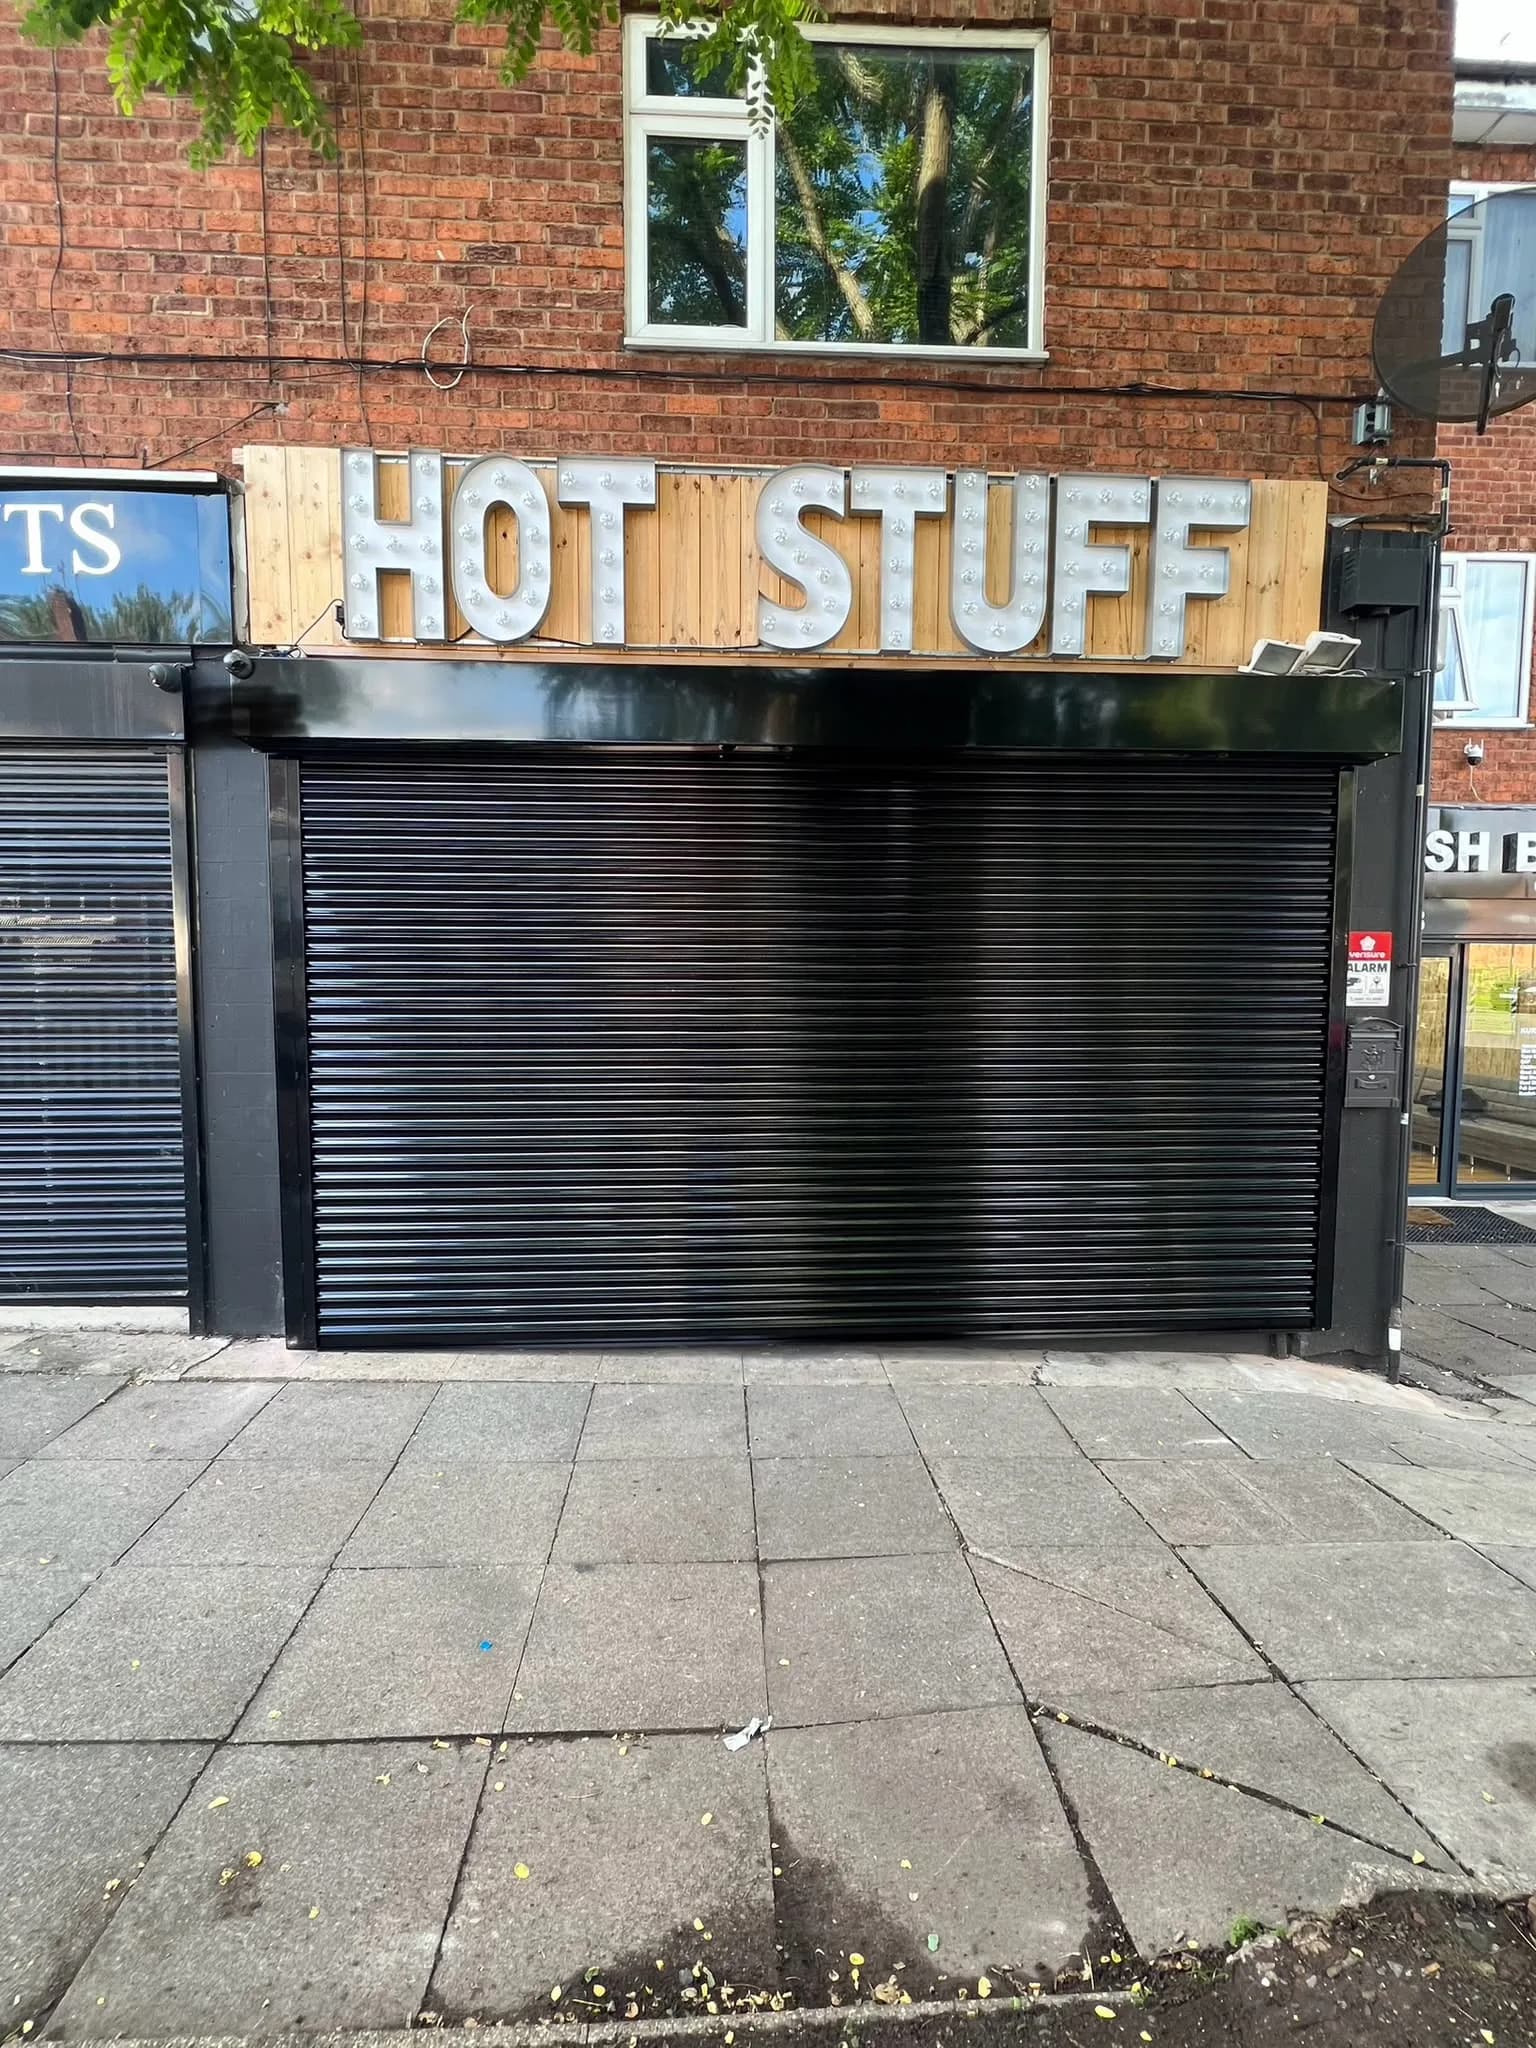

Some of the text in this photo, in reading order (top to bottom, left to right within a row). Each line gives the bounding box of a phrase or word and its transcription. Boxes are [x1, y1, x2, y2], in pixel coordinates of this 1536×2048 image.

[0, 502, 121, 575] TS
[341, 448, 1252, 661] HOT STUFF
[1424, 830, 1490, 872] SH
[1347, 962, 1388, 973] ALARM
[1349, 951, 1386, 959] verisure
